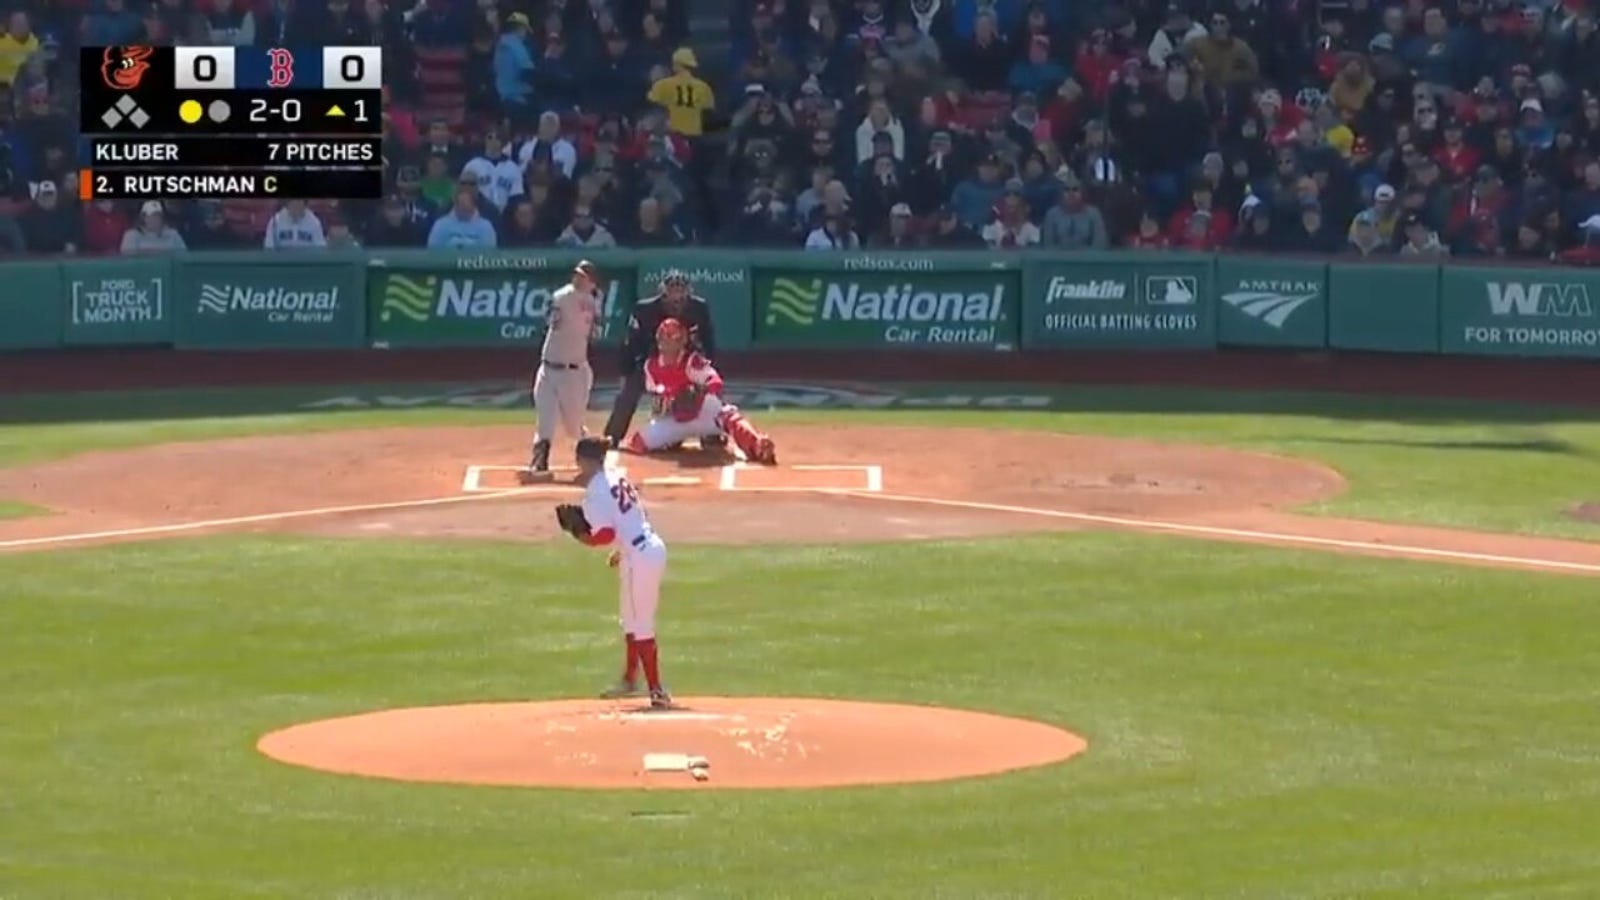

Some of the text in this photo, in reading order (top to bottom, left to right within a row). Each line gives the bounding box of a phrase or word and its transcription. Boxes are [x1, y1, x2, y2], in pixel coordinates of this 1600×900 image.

[676, 85, 694, 108] 11
[457, 255, 548, 269] redsox.com
[843, 256, 934, 271] redsox.com
[101, 280, 135, 290] FORD
[1239, 280, 1318, 292] AMTRAK
[85, 290, 148, 308] TRUCK
[231, 286, 338, 310] National
[436, 280, 619, 317] Natiol
[822, 283, 1004, 321] National
[1486, 282, 1592, 317] WM
[84, 305, 152, 323] MONTH
[268, 312, 334, 323] Car Rental
[1045, 313, 1197, 330] OFFICIAL BATTING GLOVES
[501, 322, 536, 339] Car
[885, 326, 995, 342] Car Rental
[1464, 326, 1600, 345] FOR TOMORRO
